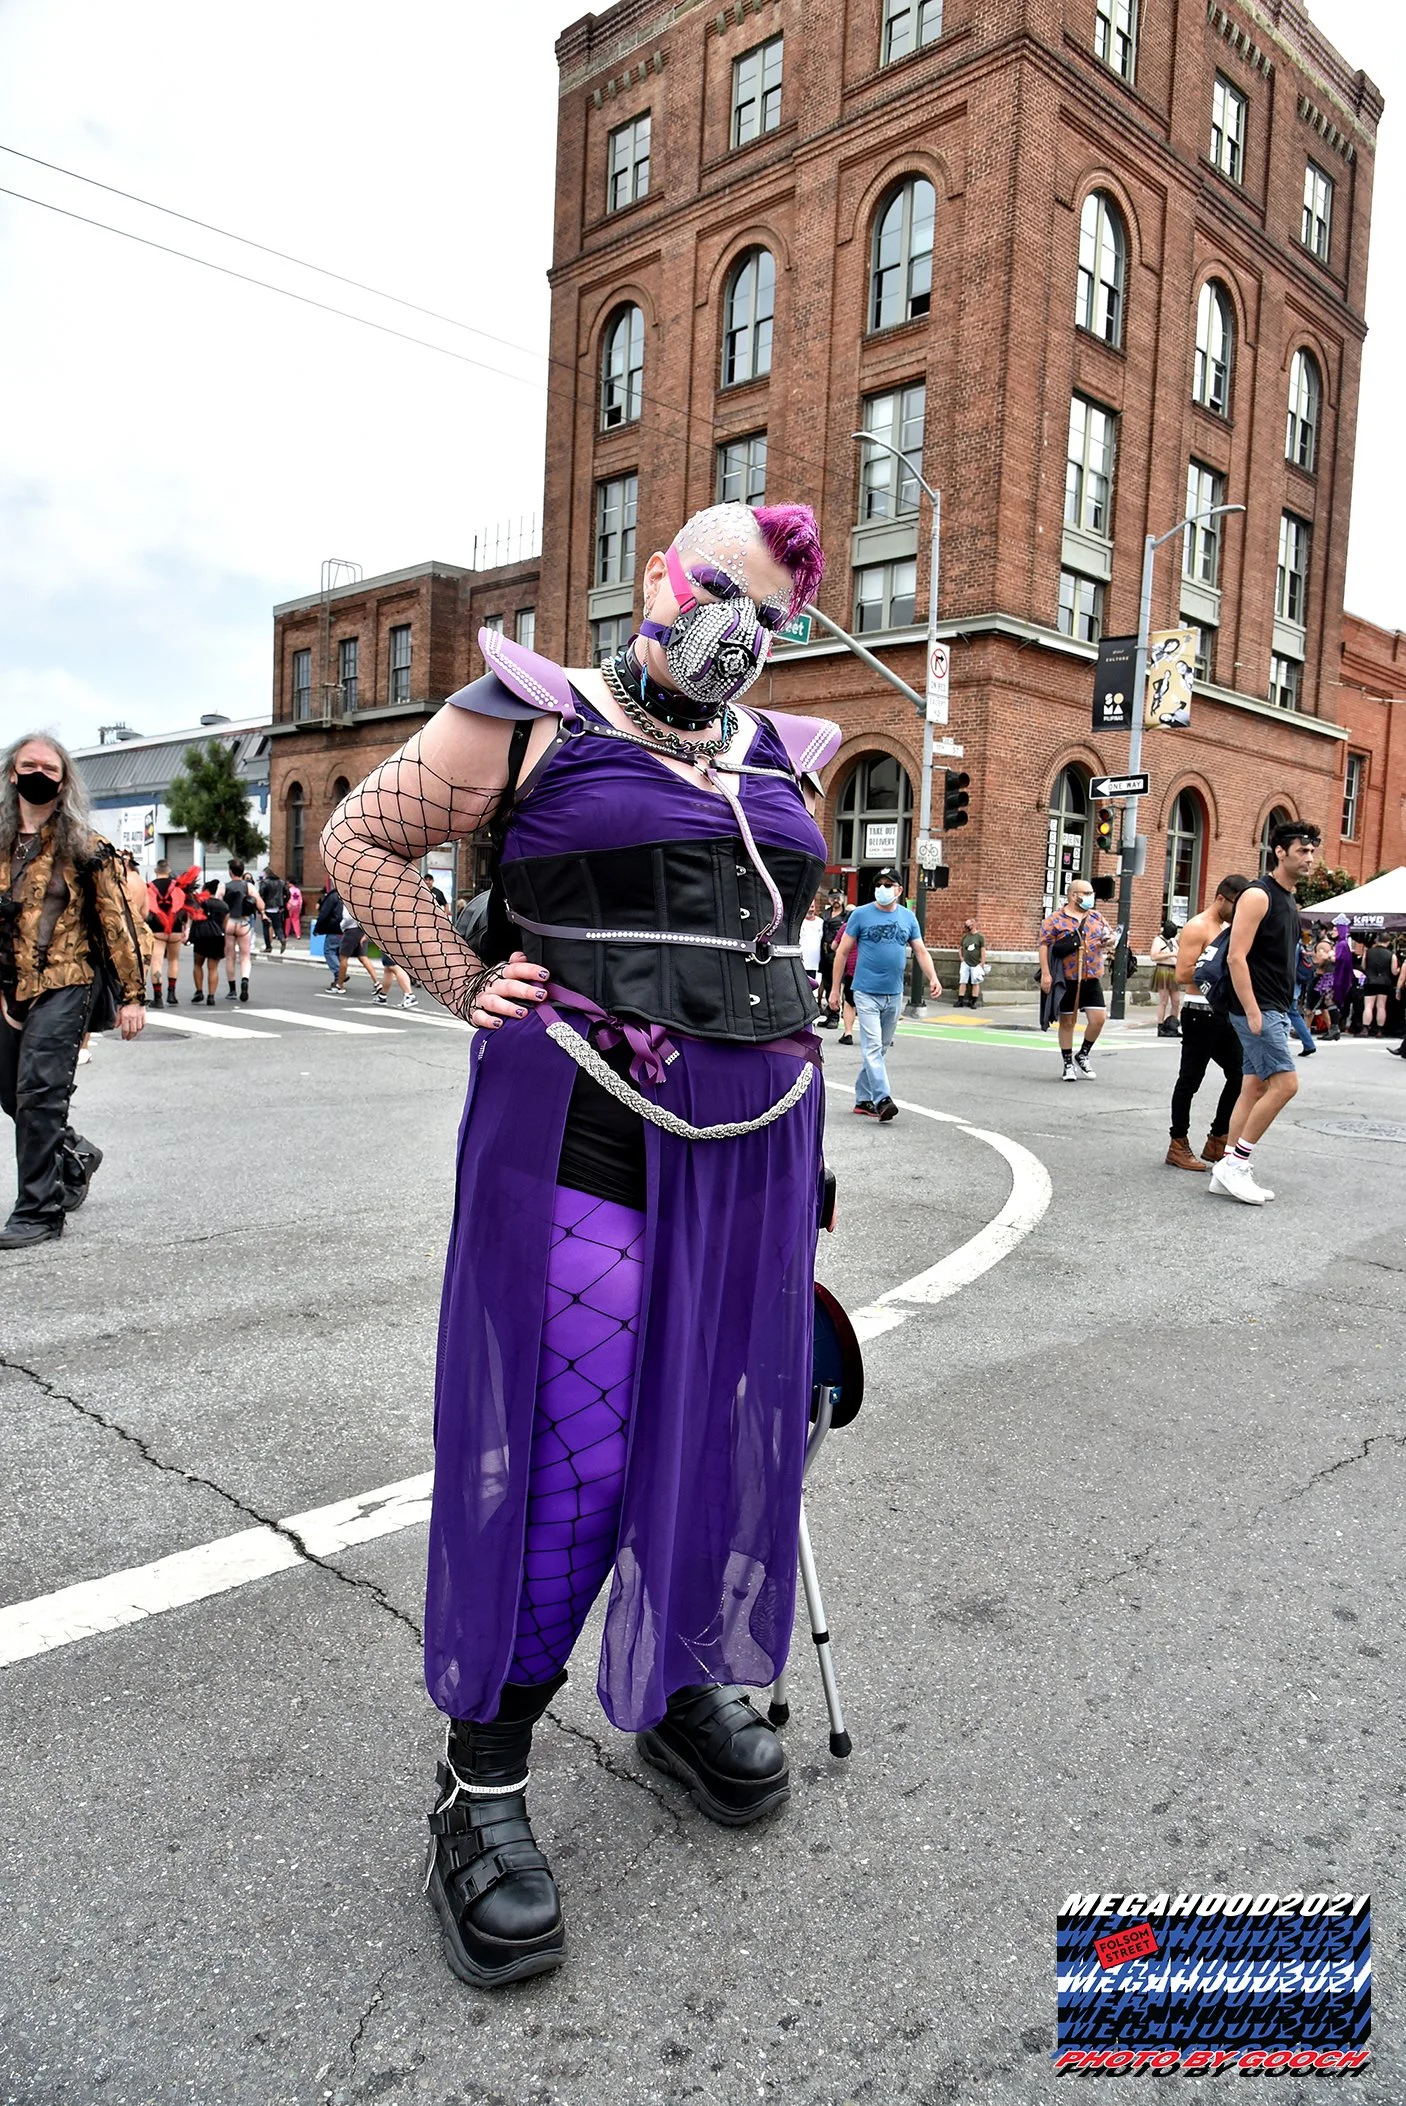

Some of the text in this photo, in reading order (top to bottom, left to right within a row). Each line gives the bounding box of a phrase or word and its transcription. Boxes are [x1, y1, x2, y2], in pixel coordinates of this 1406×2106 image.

[1107, 780, 1142, 791] ONE WAY
[869, 827, 896, 835] TAKE OUT
[868, 838, 896, 846] DELIVERY
